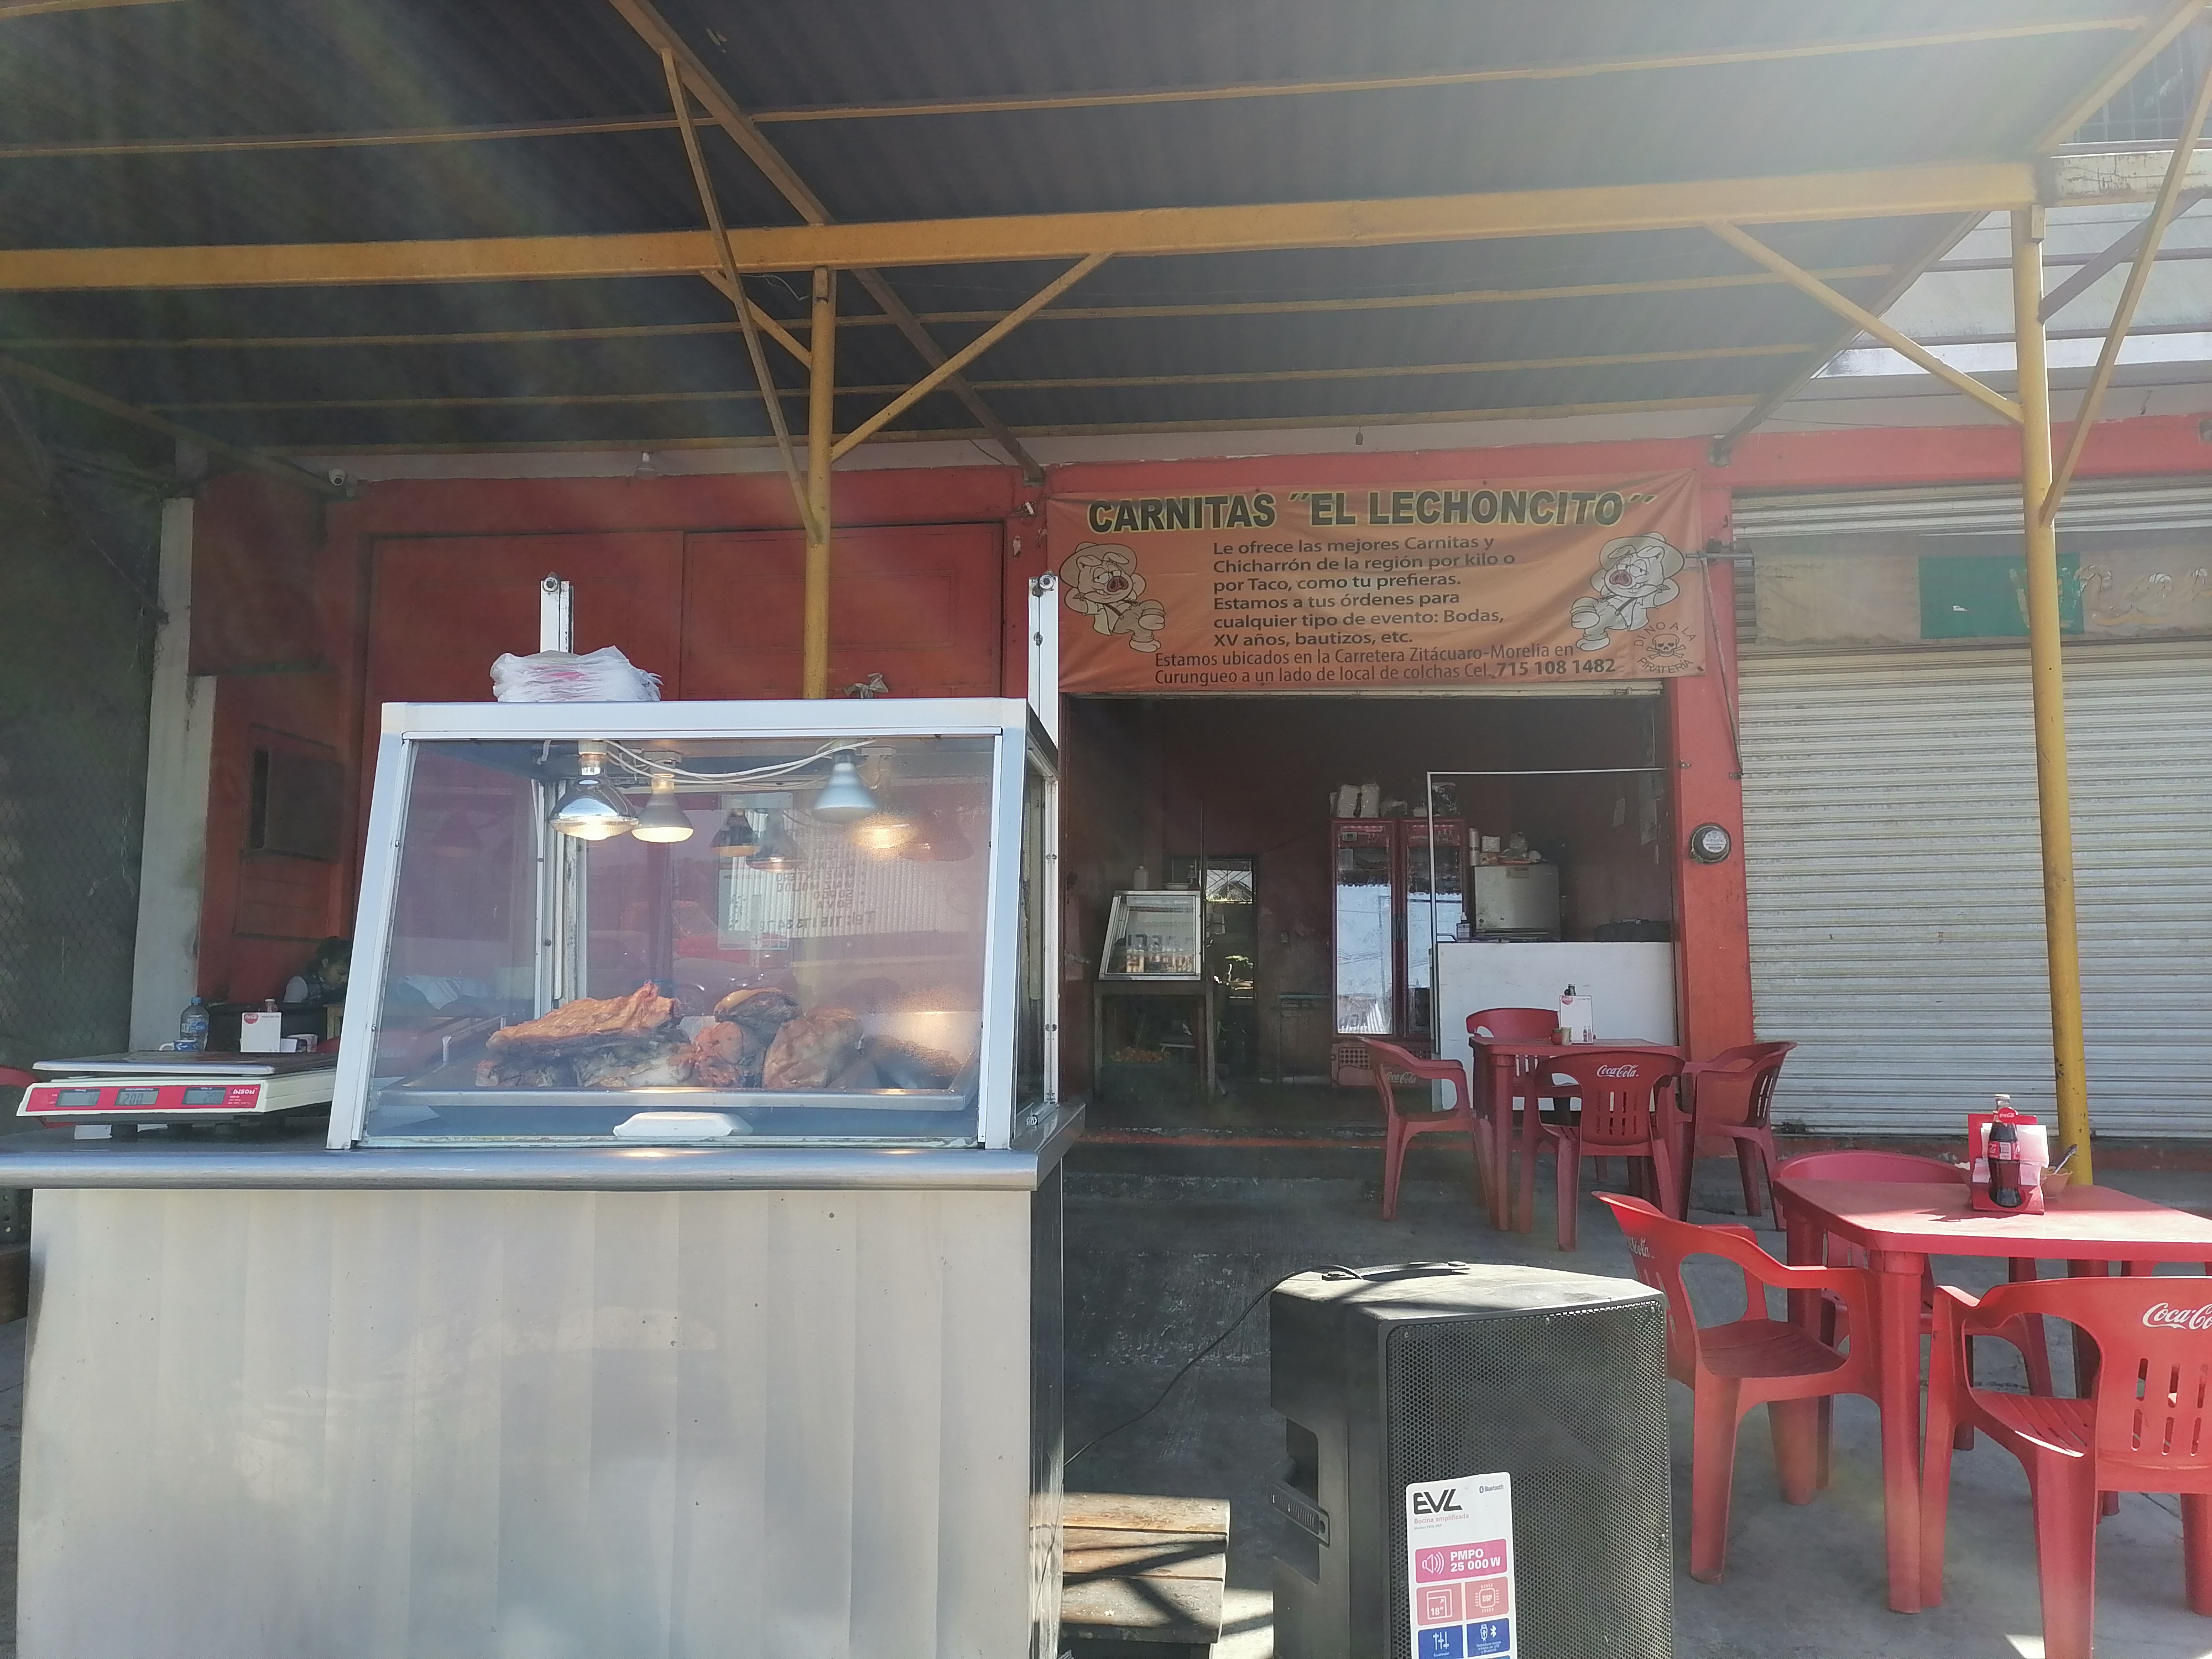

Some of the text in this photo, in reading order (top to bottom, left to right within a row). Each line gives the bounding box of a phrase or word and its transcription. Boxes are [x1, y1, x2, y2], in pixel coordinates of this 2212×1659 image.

[1088, 493, 1276, 533] CARNITAS
[1214, 536, 1494, 555] Le ofrece las mejores Carnitas y
[1213, 553, 1515, 573] Chicharrón de la región por kilo o
[1214, 573, 1461, 594] por Taco, como tu prefieras.
[1214, 593, 1459, 609] Estamos a tus órdenes para
[1213, 608, 1504, 630] cualquier tipo de evento: Bodas,
[1214, 632, 1412, 646] XV años, bautizos, etc.
[1634, 635, 1646, 646] DI
[1644, 622, 1666, 635] NO
[1682, 627, 1697, 641] LA
[1155, 644, 1574, 667] Estamos ubicados en la Carretera Zitácuaro-Morelia en
[1155, 658, 1615, 686] Curungueo a un lado de local de colchas Cel. 715 108 1482
[1597, 1064, 1638, 1078] Coca-Cola
[1413, 1488, 1463, 1515] EVL
[1436, 1513, 1469, 1524] amplificada
[1450, 1548, 1484, 1562] PMPO
[1451, 1556, 1501, 1572] 25 000 W
